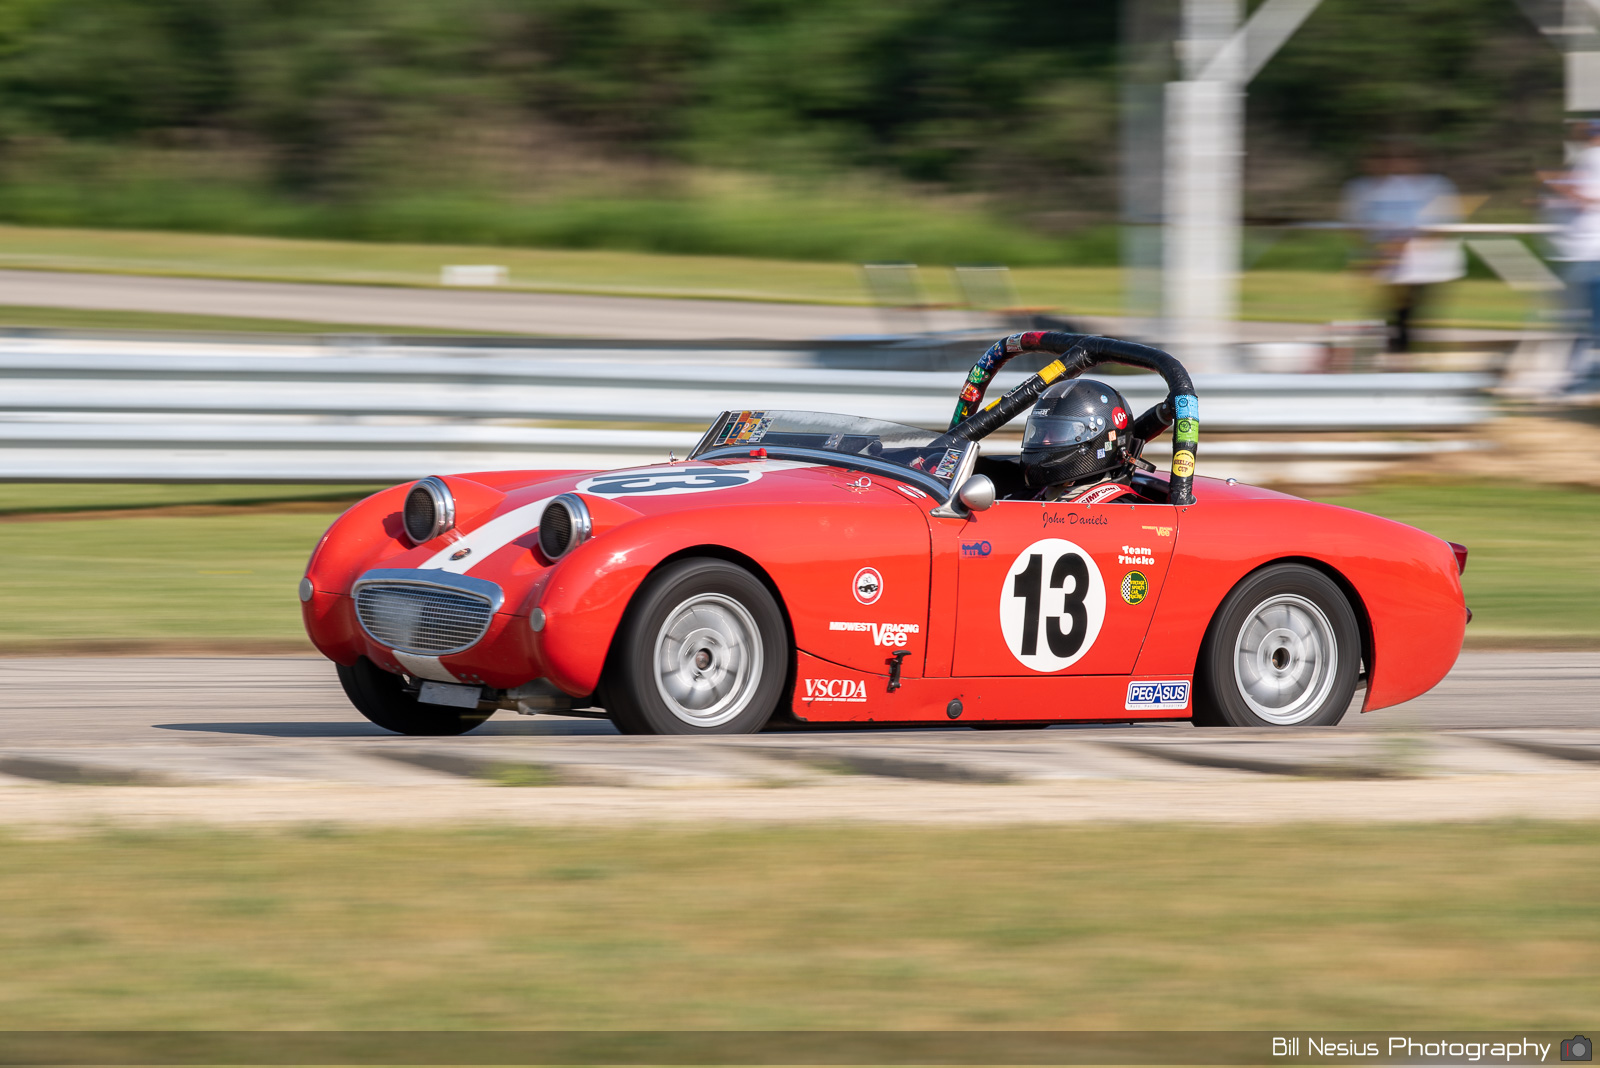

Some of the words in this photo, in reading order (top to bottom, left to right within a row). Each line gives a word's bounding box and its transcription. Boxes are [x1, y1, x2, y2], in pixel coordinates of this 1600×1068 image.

[587, 468, 750, 494] 13
[1042, 512, 1065, 528] John
[1068, 512, 1108, 525] Daniels
[1121, 545, 1152, 556] Team
[1117, 555, 1155, 566] Thicko
[1013, 552, 1090, 659] 13
[829, 621, 873, 632] MIDWEST
[886, 623, 919, 633] RACING
[871, 623, 907, 647] Vee
[804, 678, 867, 698] VSCDA
[1131, 683, 1185, 702] PEGASUS
